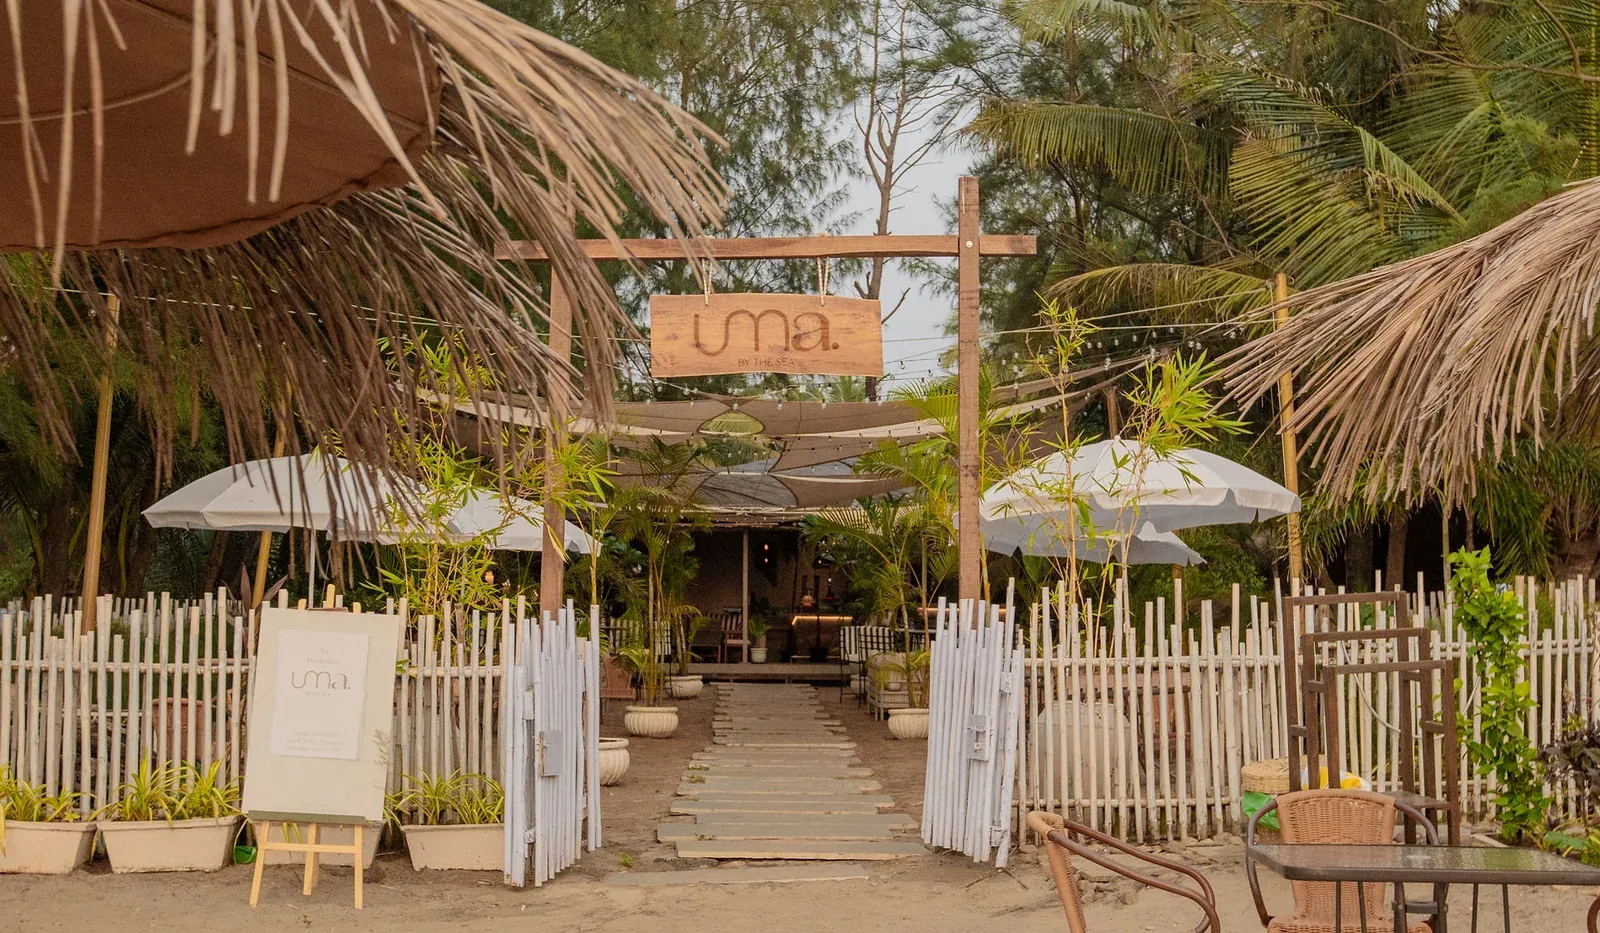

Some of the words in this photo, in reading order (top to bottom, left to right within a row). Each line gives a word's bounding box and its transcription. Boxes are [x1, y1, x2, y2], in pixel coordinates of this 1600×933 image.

[738, 357, 749, 367] BY
[753, 357, 773, 367] THE
[776, 357, 796, 367] SEA
